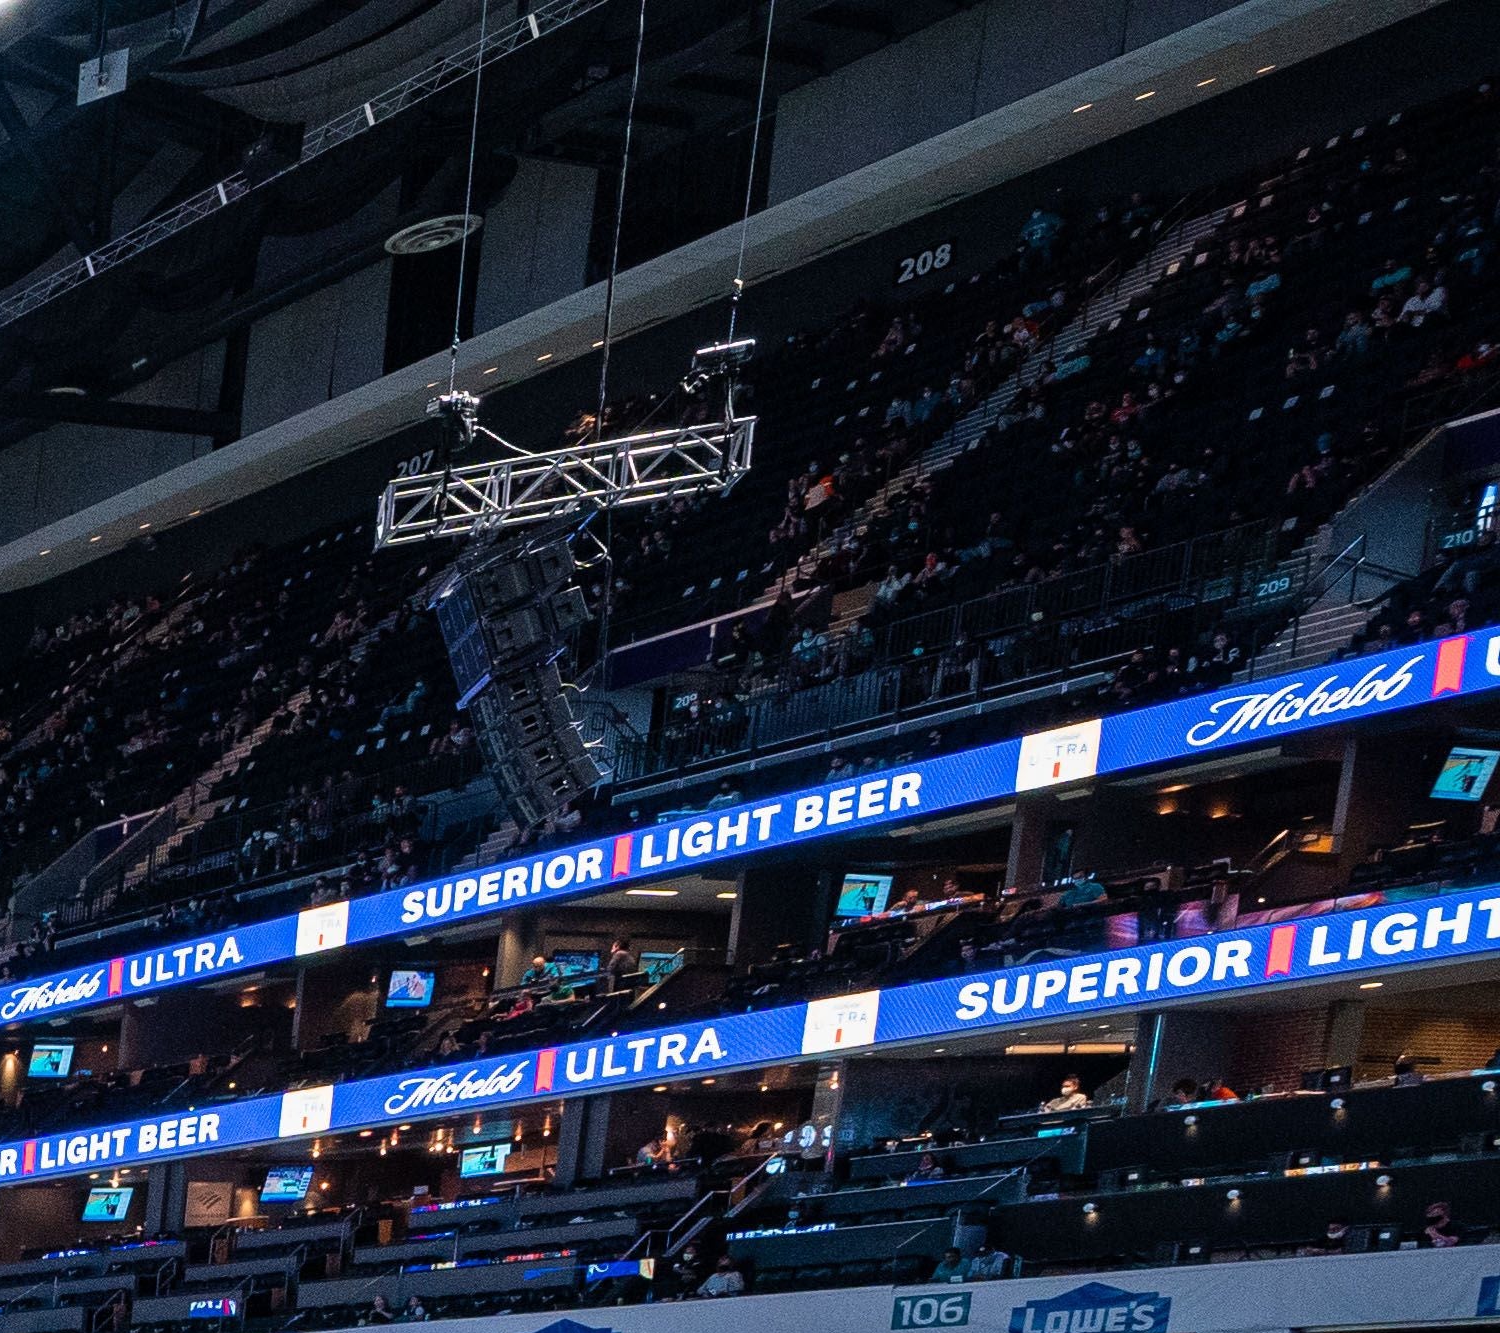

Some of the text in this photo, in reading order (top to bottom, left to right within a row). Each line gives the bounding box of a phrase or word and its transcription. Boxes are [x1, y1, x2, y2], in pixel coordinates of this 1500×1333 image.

[899, 243, 952, 283] 208
[393, 453, 434, 479] 207
[1443, 529, 1473, 546] 210
[1258, 577, 1290, 597] 209
[1186, 655, 1424, 746] Michelob
[401, 773, 921, 923] SUPERIOR LIGHT BEER
[1, 936, 244, 1019] Michelob ULTRA
[955, 900, 1500, 1022] SUPERIOR LIGHT
[385, 1028, 727, 1114] Michelob ULTRA
[41, 1128, 131, 1174] LIGHT
[138, 1114, 220, 1153] BEER
[898, 1296, 965, 1328] 106
